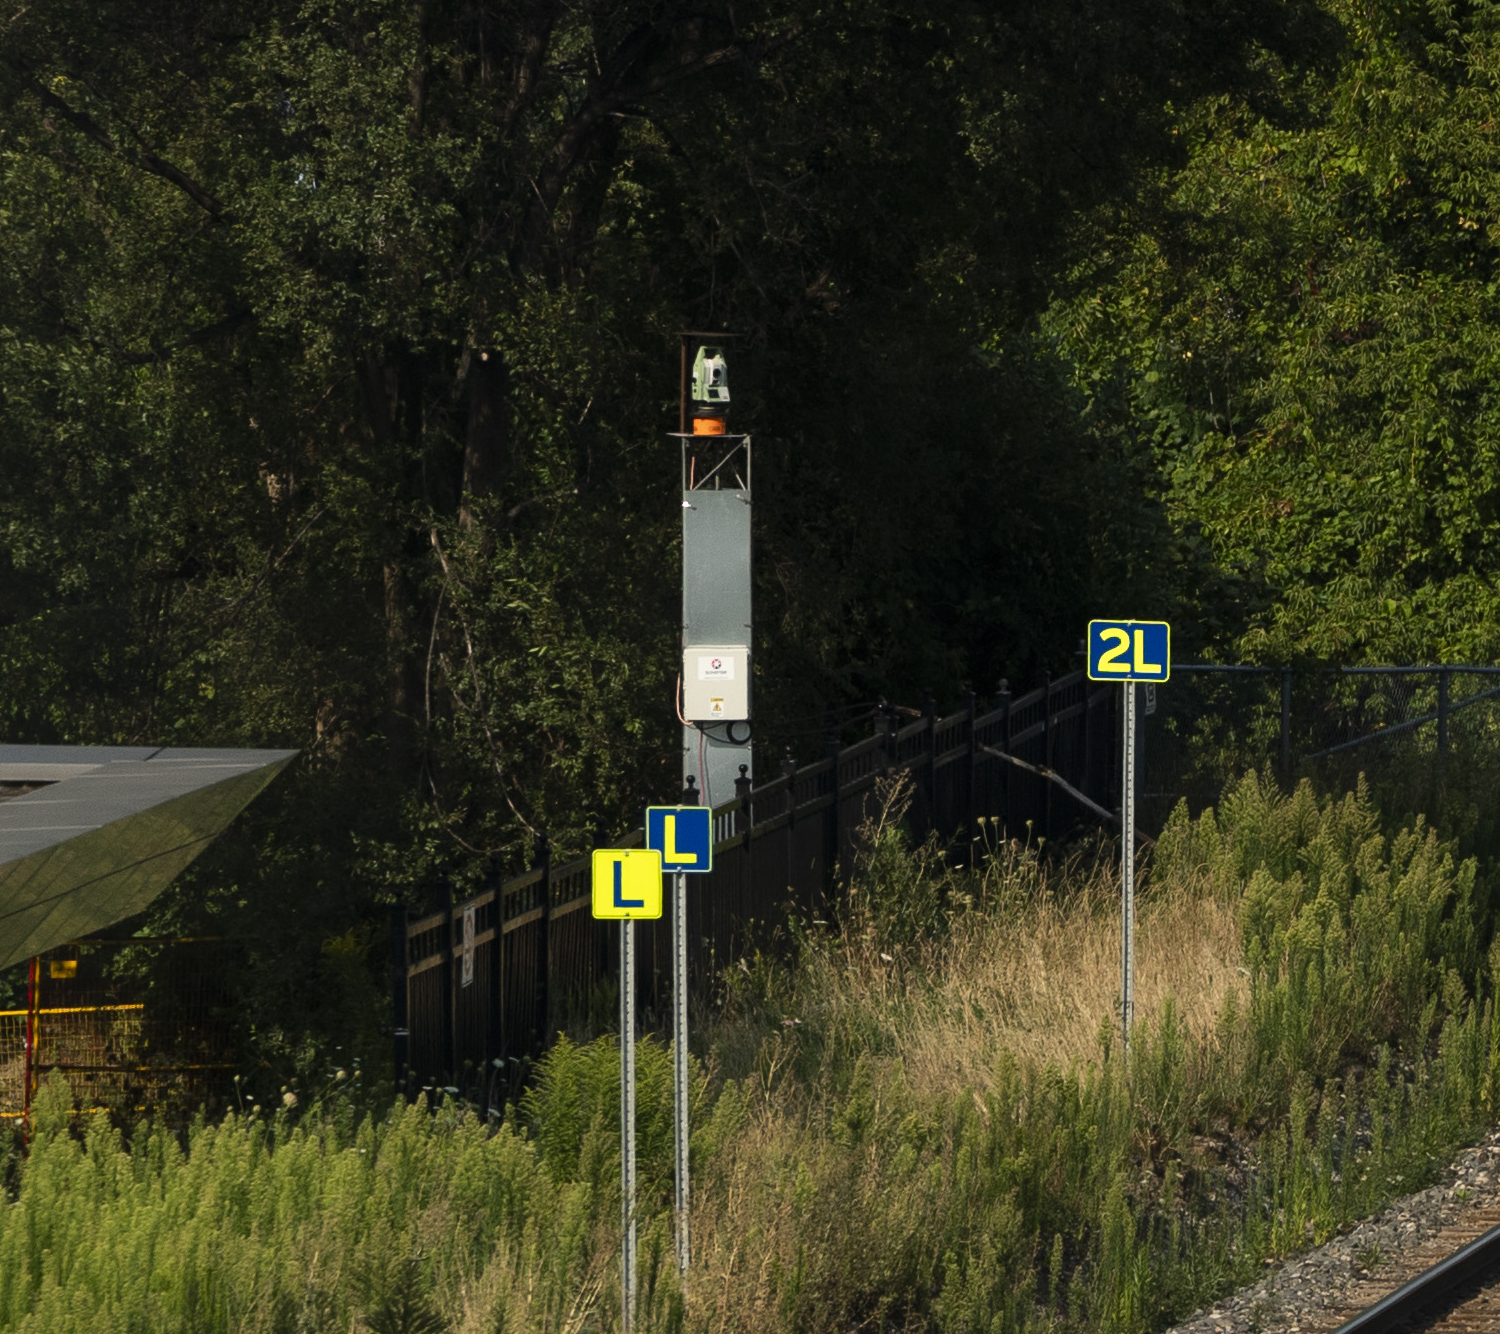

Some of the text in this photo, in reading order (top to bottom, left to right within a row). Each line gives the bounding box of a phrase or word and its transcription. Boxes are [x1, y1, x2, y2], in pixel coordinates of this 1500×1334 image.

[1097, 627, 1162, 673] 2L
[664, 815, 698, 864] L
[612, 860, 645, 908] L
